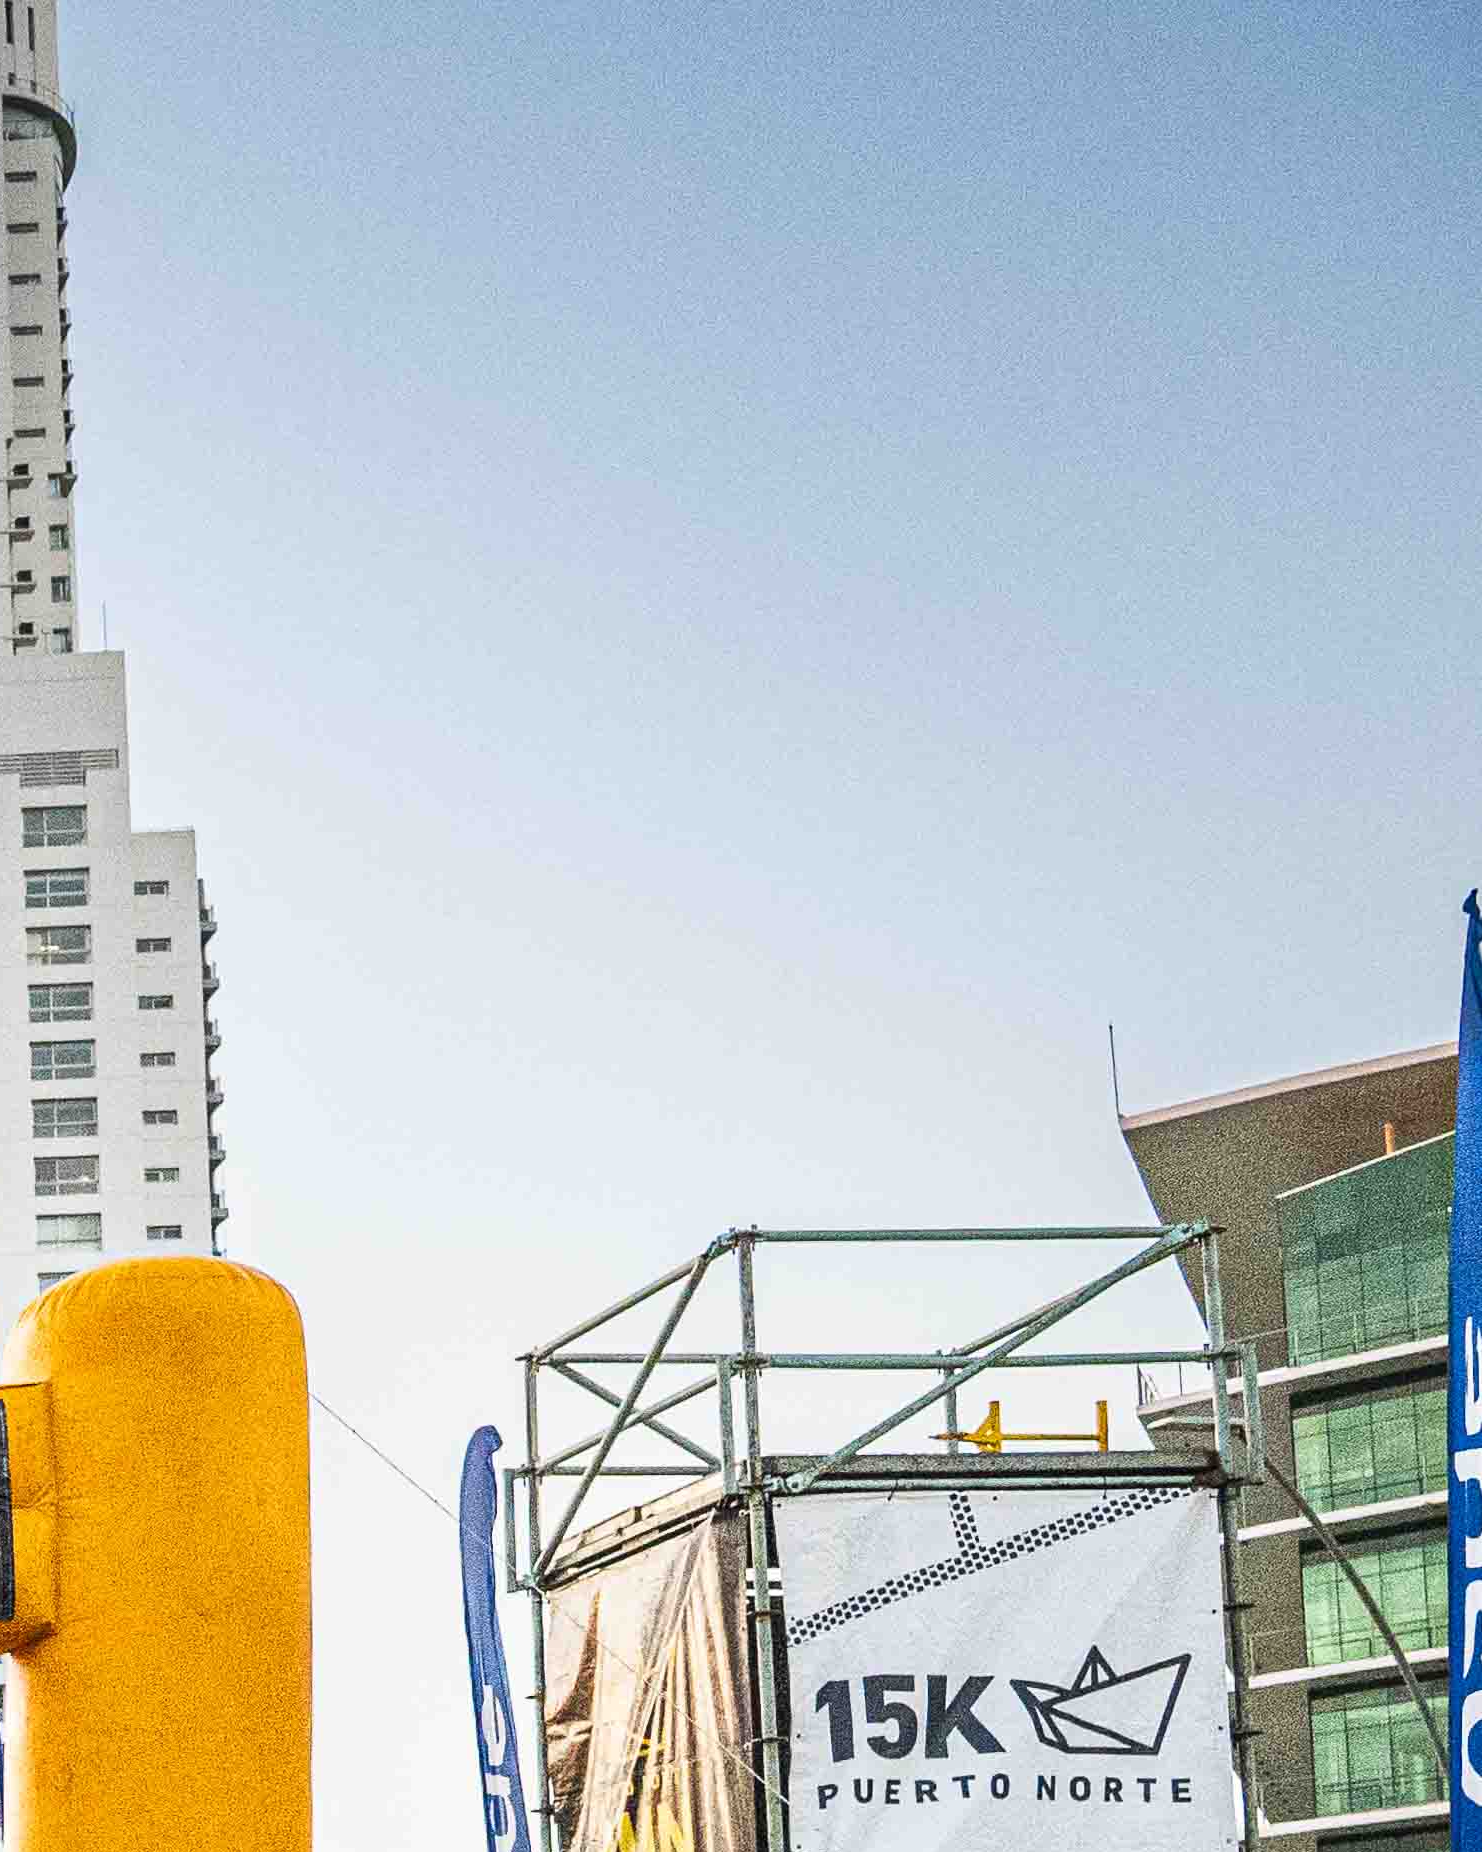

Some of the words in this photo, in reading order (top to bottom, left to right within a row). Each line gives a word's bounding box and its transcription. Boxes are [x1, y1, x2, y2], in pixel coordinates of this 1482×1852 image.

[815, 1675, 1007, 1762] 15K
[817, 1773, 1010, 1809] PUERTO
[1037, 1775, 1192, 1803] NORTE
